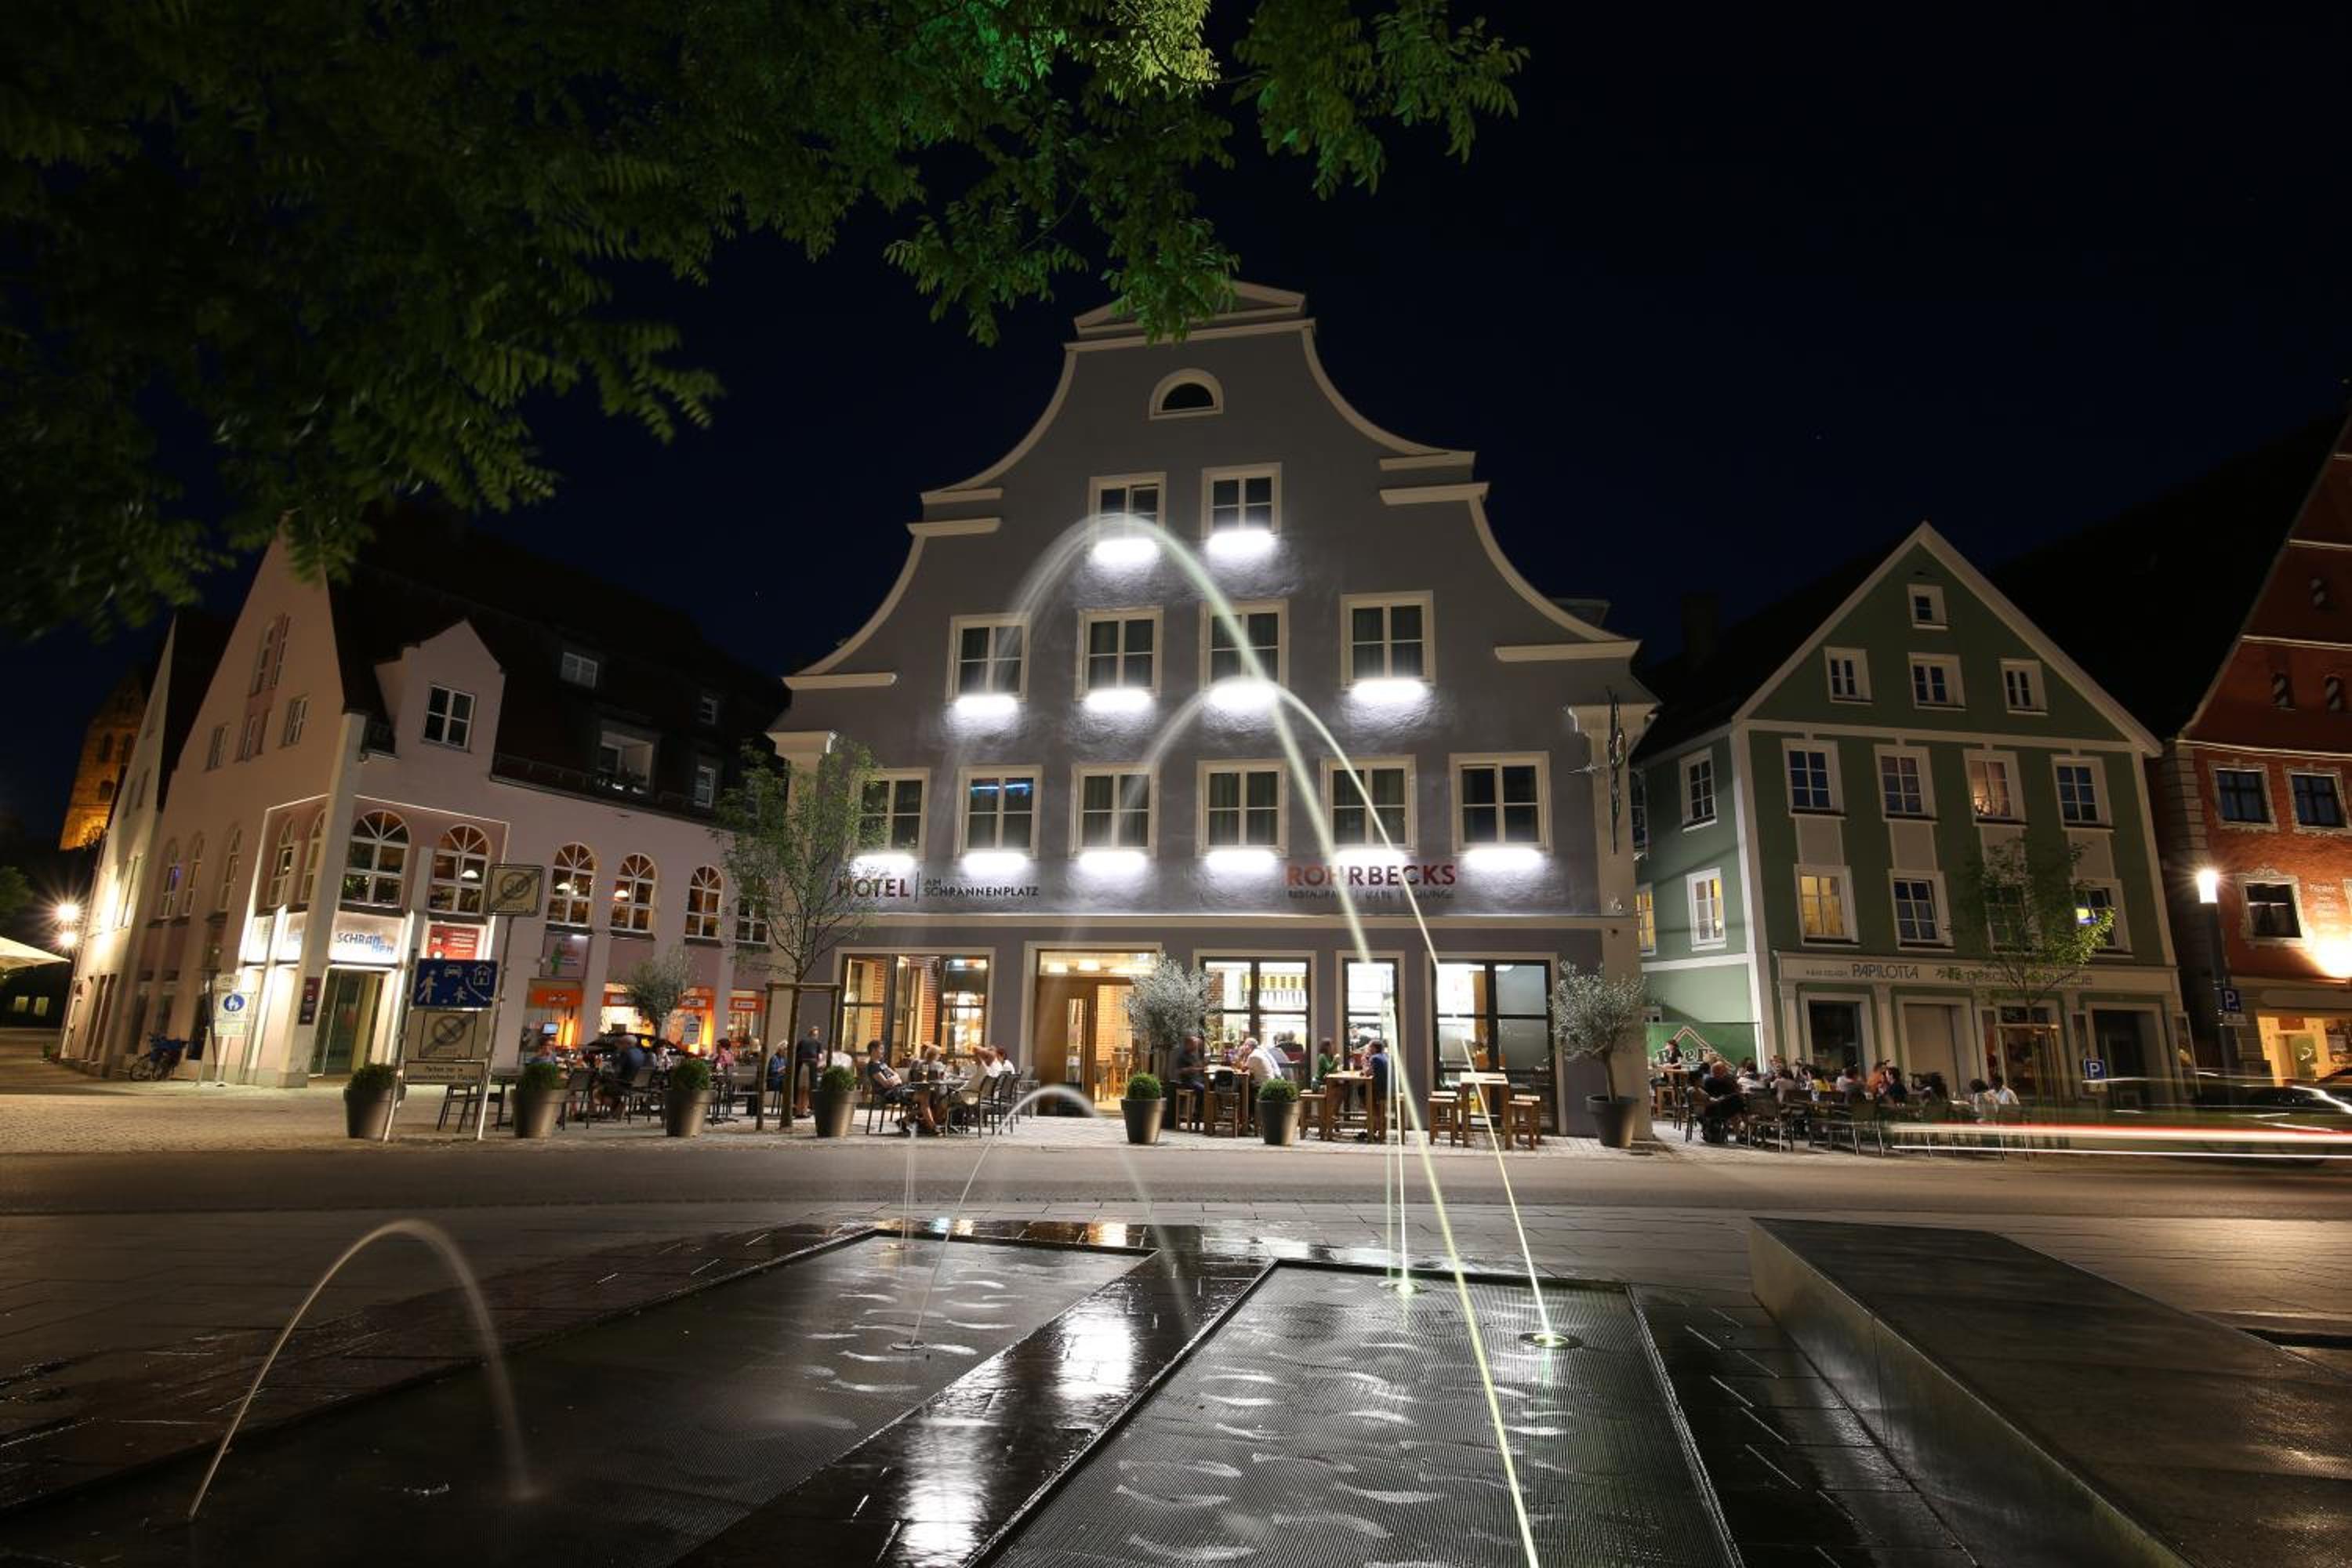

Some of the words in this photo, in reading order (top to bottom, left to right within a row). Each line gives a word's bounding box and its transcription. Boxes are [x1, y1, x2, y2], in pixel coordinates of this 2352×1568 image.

[925, 878, 942, 887] AM
[1287, 865, 1456, 887] ROHRBECKS
[837, 879, 910, 898] HOTEL
[924, 886, 1040, 898] SCHRANNENPLATZ
[2089, 1062, 2100, 1080] P
